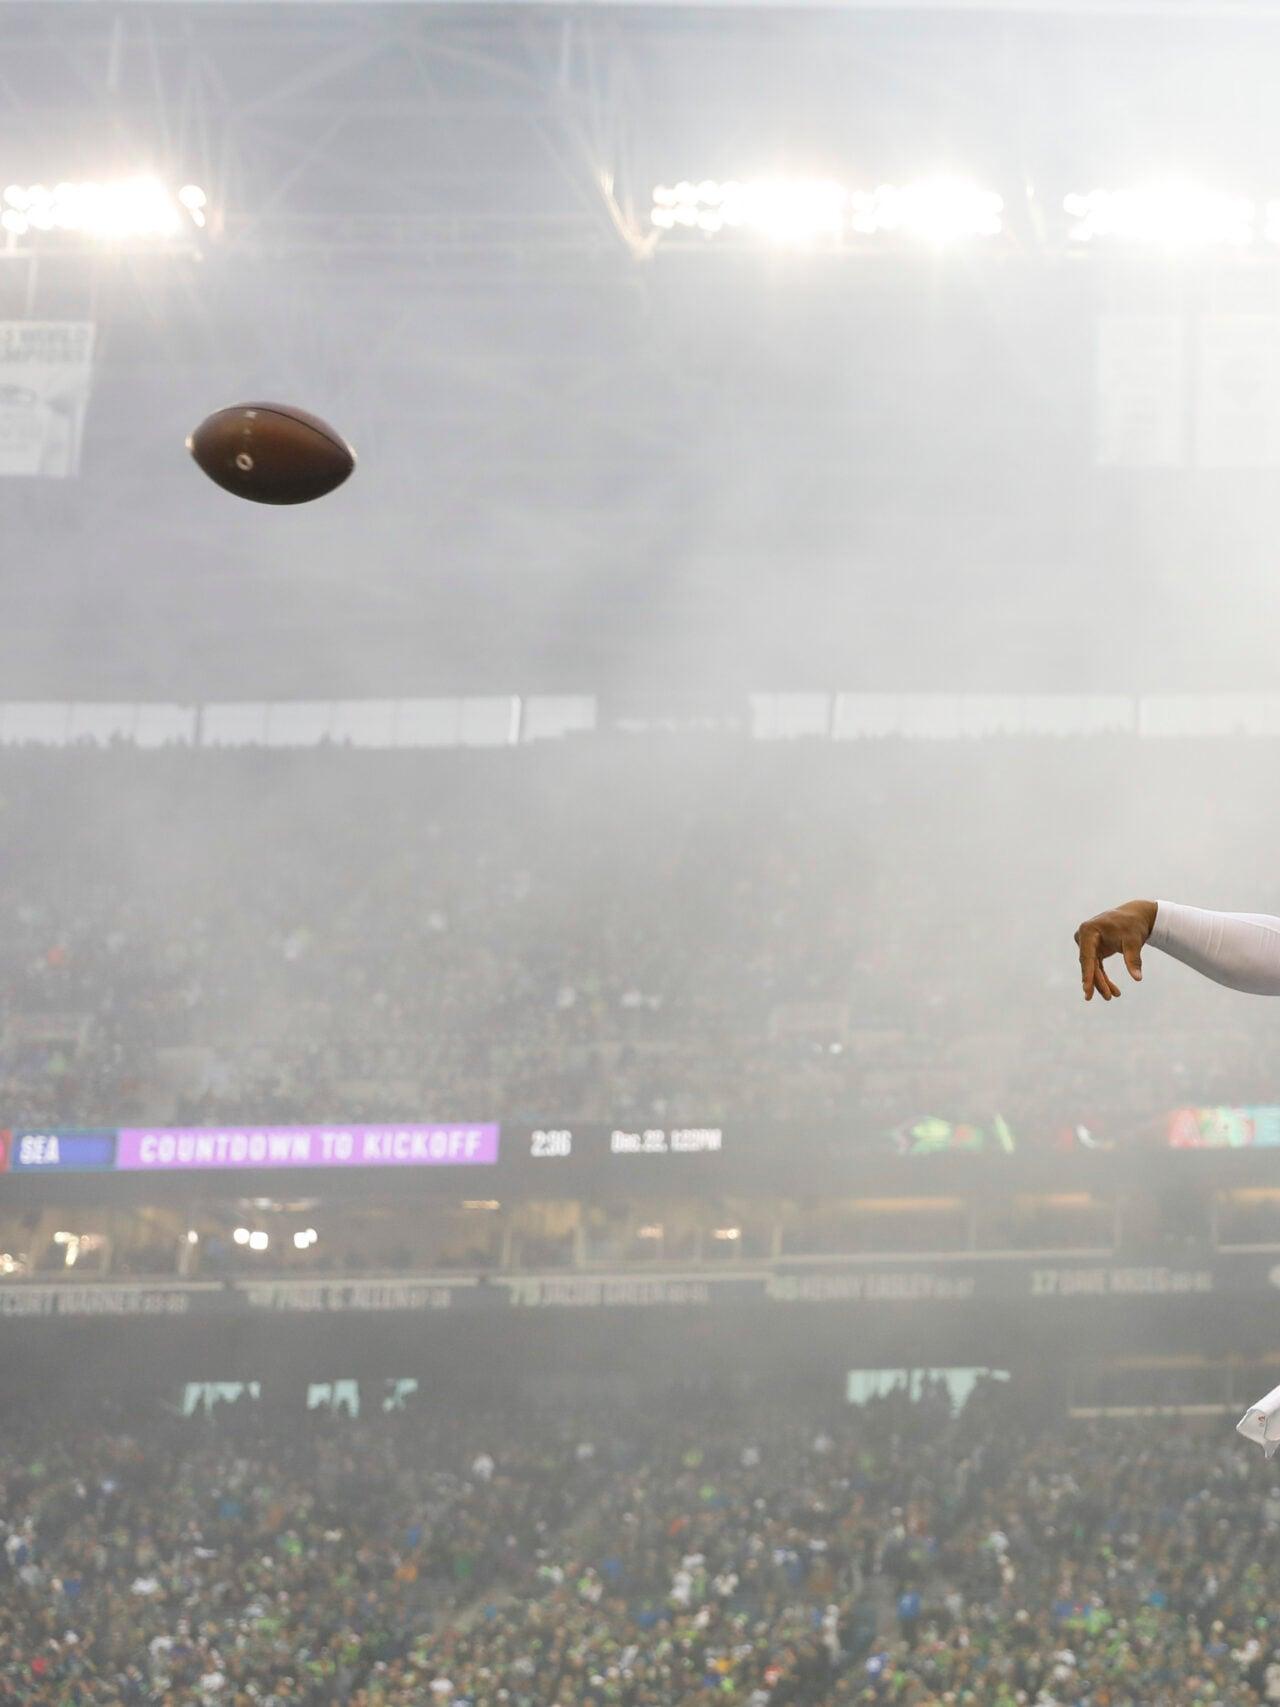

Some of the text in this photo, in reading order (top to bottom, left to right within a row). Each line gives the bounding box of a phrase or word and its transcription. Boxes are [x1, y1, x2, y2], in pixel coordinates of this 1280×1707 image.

[20, 1135, 59, 1164] SEA
[140, 1131, 481, 1162] COUNTDOWN TO KICKOFF
